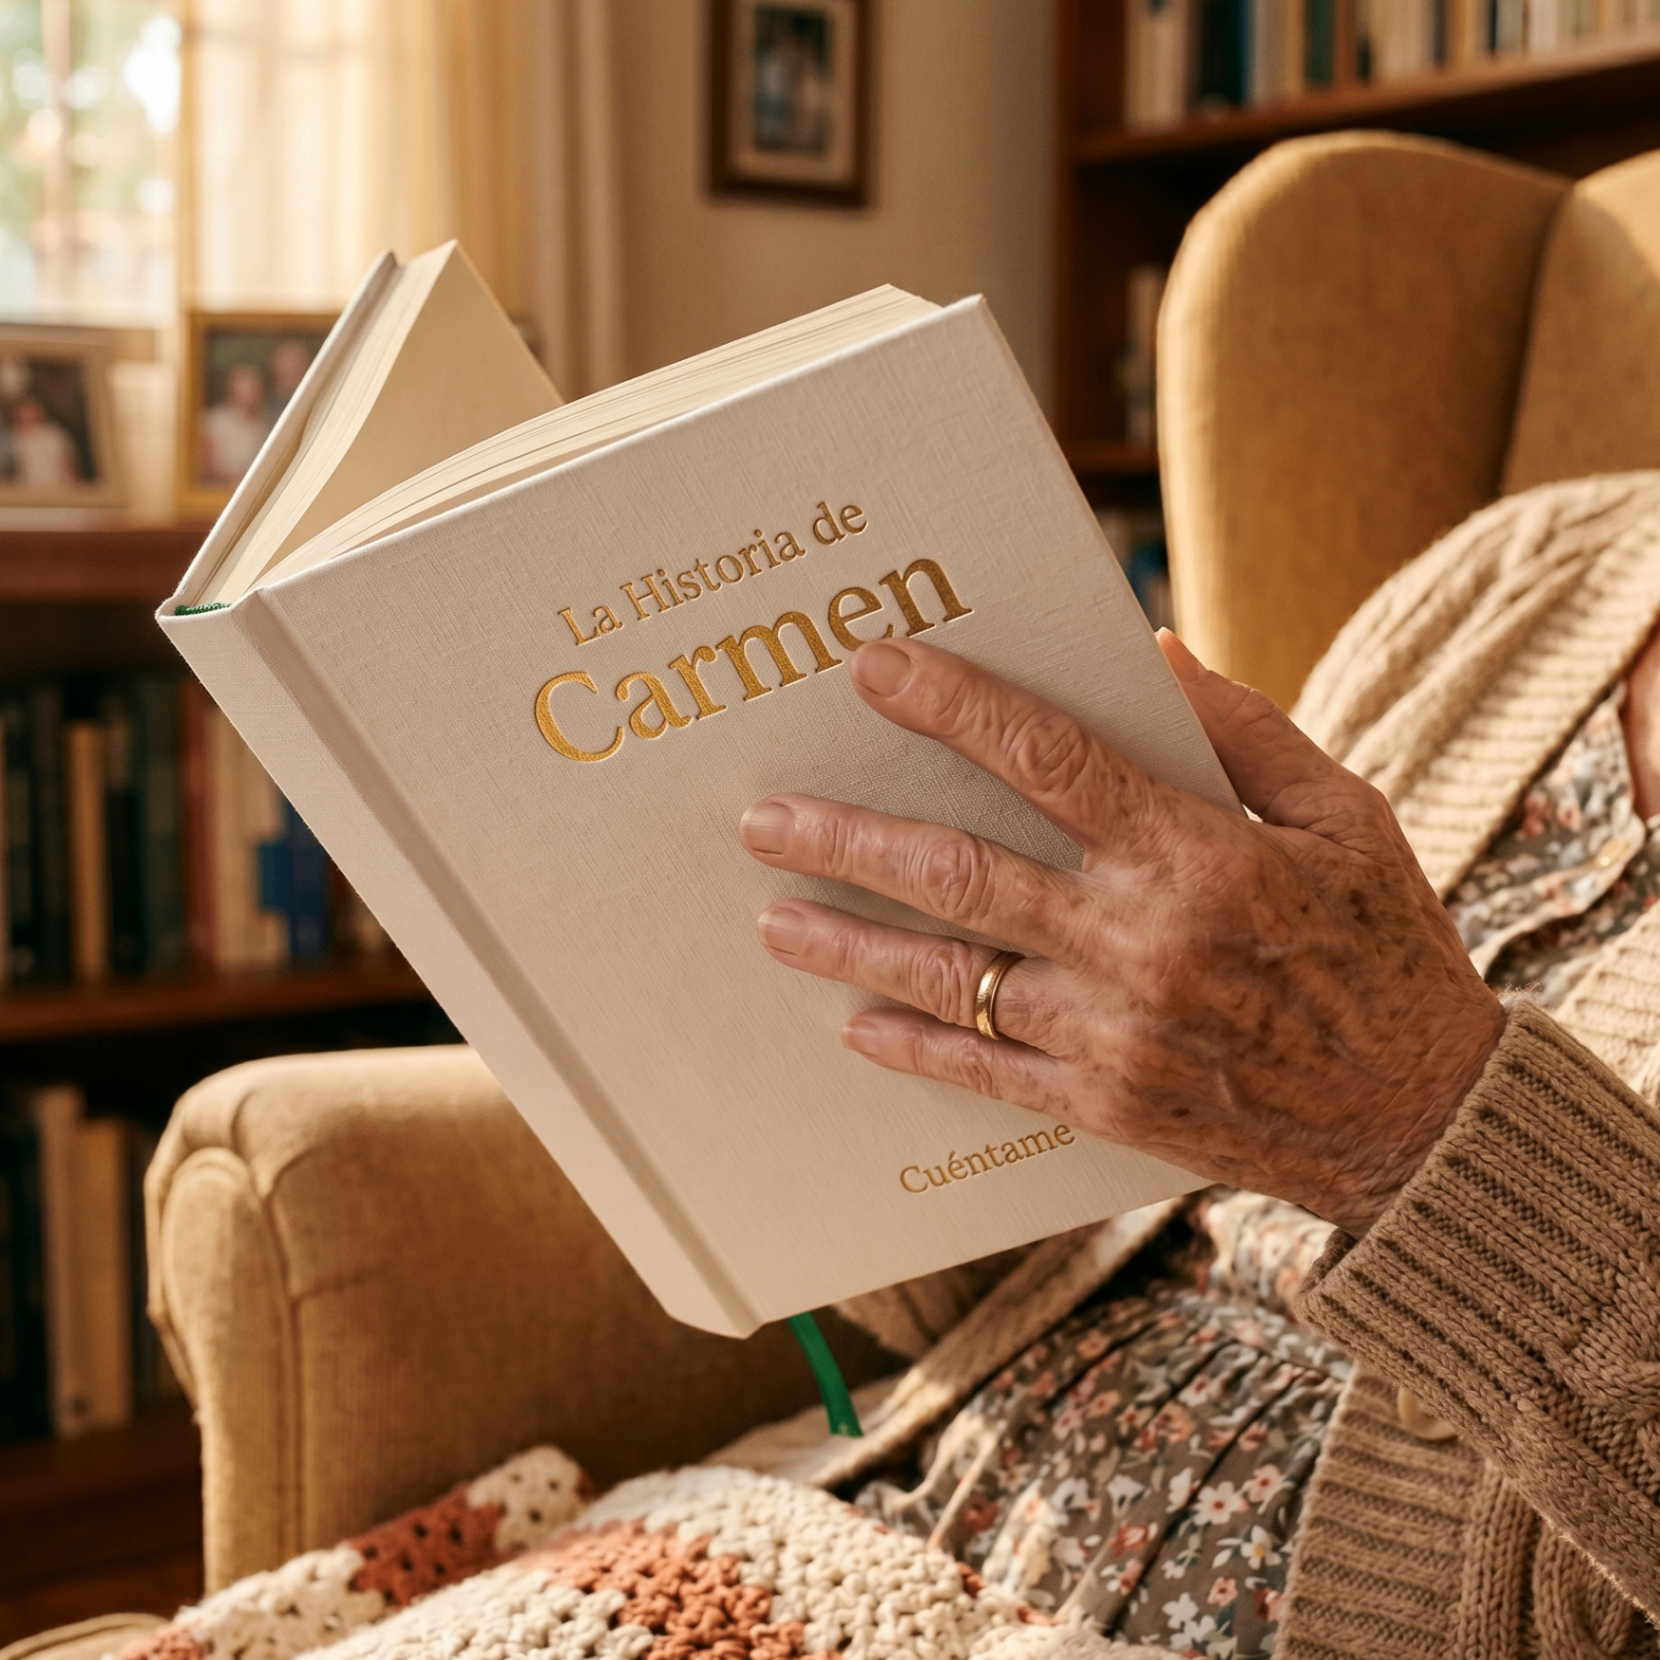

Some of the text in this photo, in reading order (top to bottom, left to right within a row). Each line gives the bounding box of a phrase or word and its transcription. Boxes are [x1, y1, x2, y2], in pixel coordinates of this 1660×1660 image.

[558, 501, 868, 646] La Historia de
[534, 558, 974, 762] Carmen
[900, 1123, 1075, 1194] Cuéntame
